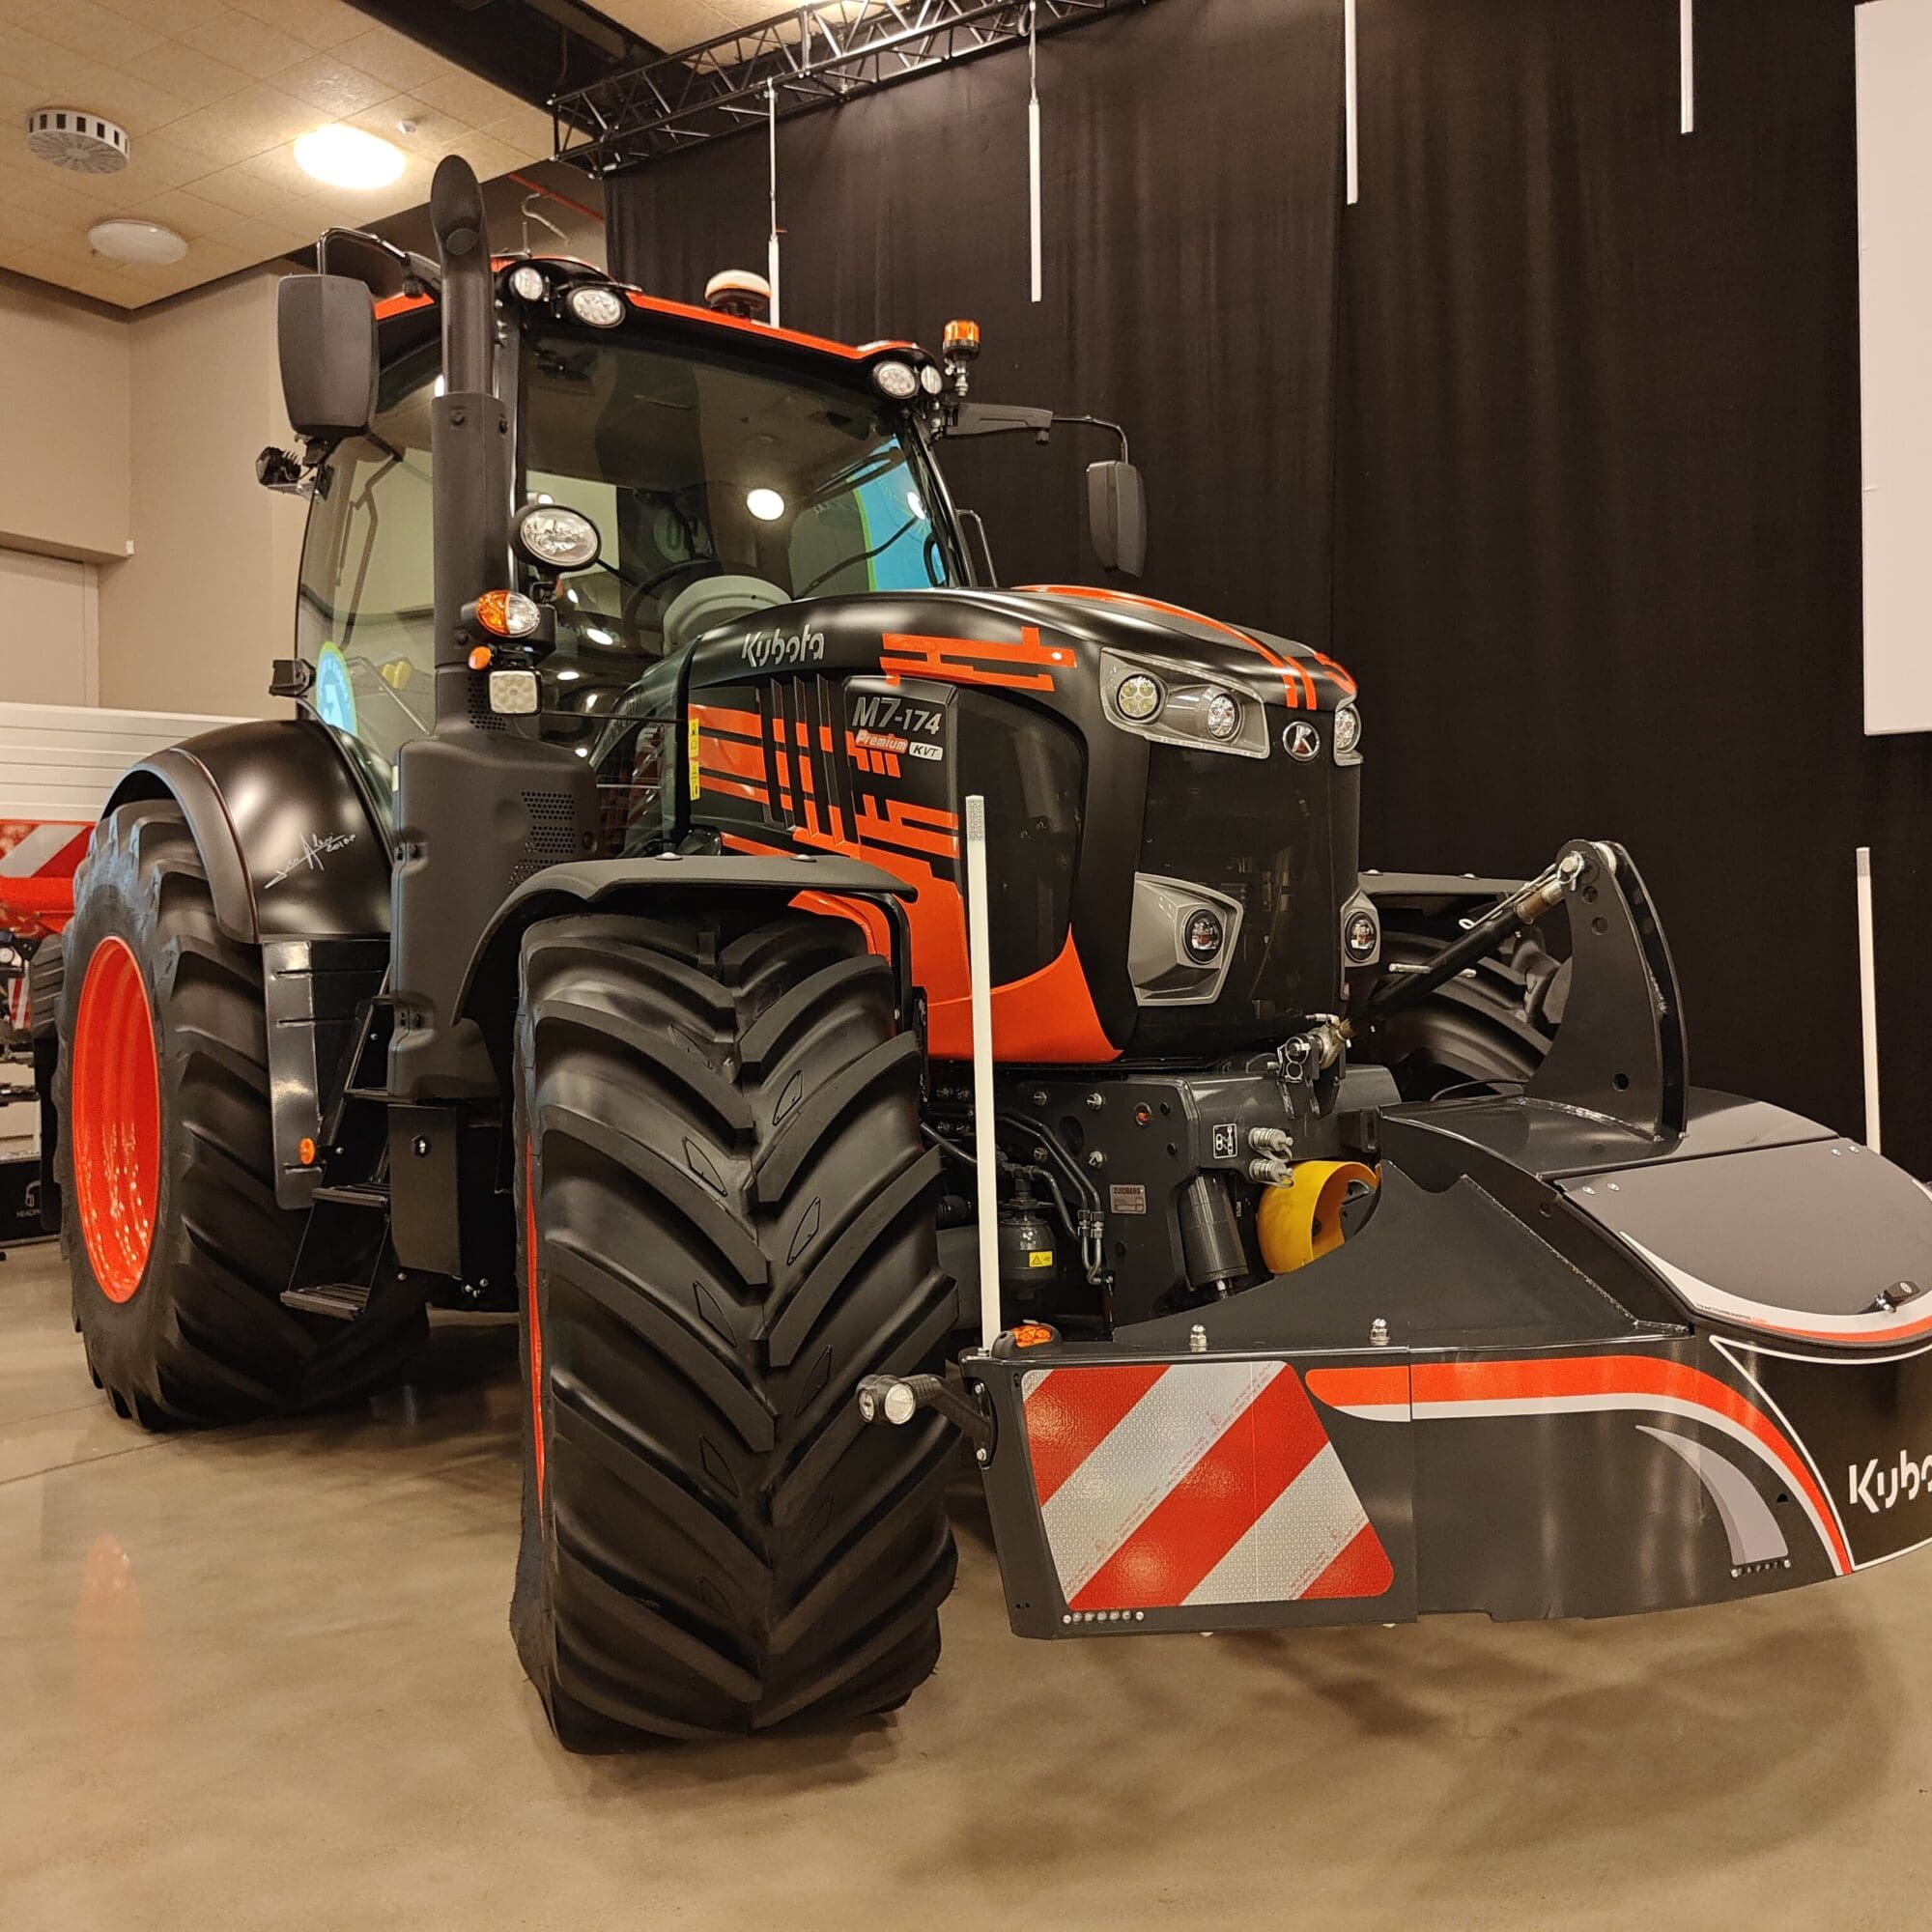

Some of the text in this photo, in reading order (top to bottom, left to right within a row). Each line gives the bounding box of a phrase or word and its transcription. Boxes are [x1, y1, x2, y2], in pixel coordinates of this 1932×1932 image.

[741, 623, 825, 668] Kubota
[852, 696, 942, 735] M7-174
[855, 730, 939, 757] Premium KVT
